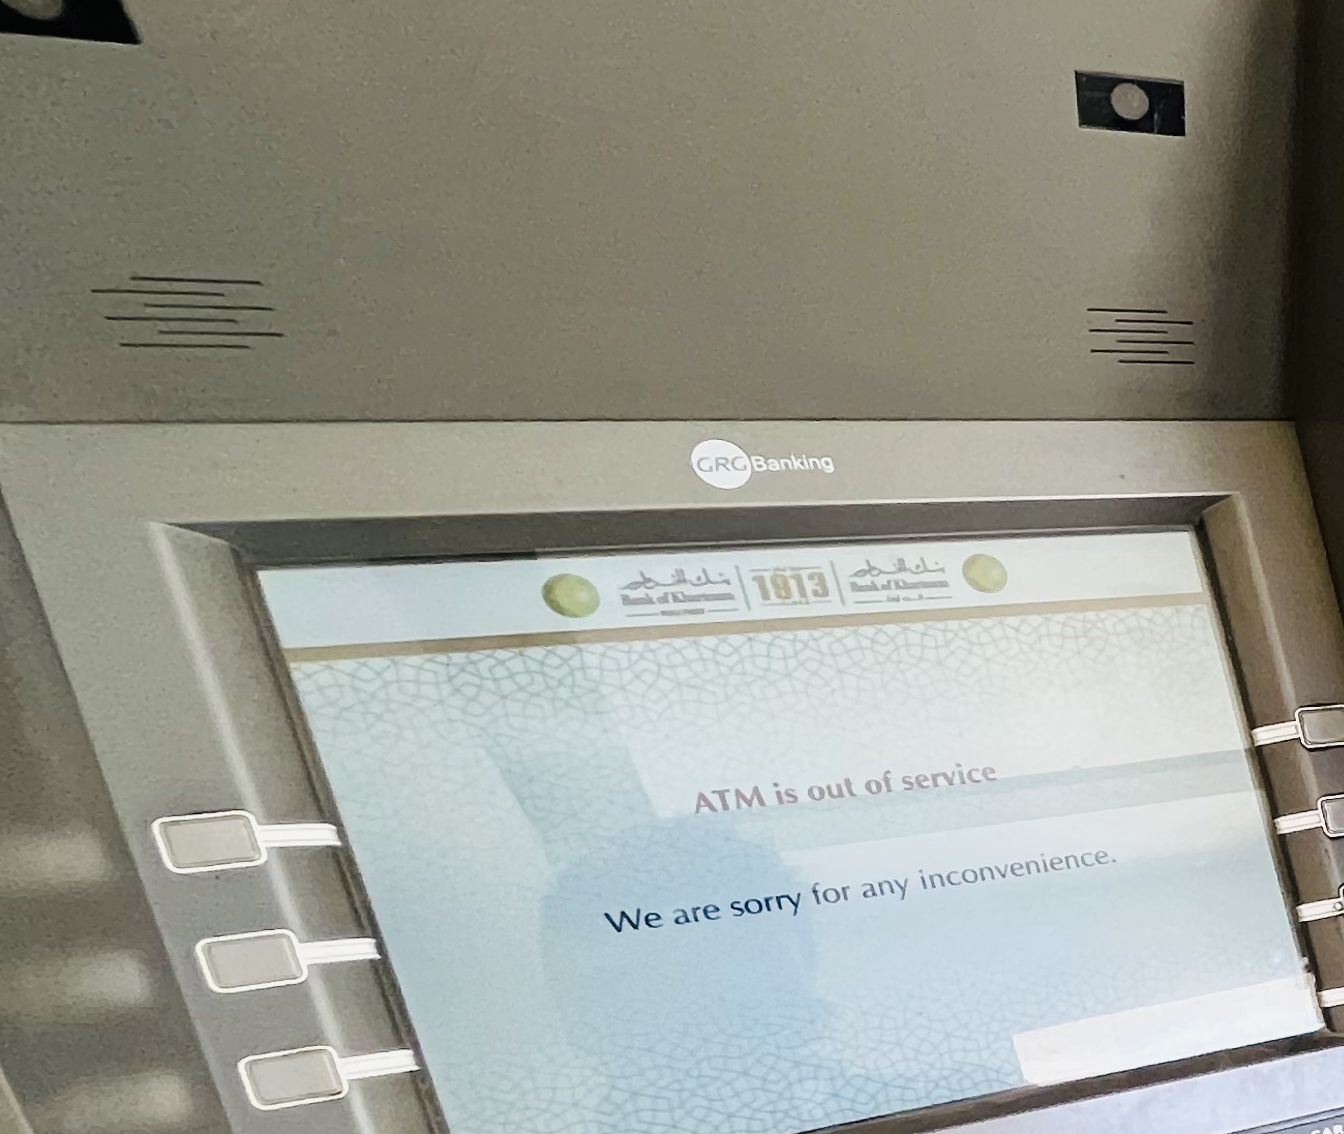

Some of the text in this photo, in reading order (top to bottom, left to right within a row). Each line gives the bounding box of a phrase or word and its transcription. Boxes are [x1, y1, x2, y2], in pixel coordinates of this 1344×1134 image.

[751, 452, 835, 473] Banking
[694, 763, 997, 815] ATM is out of service
[604, 848, 1117, 933] We are sorry for any inconvenience.
